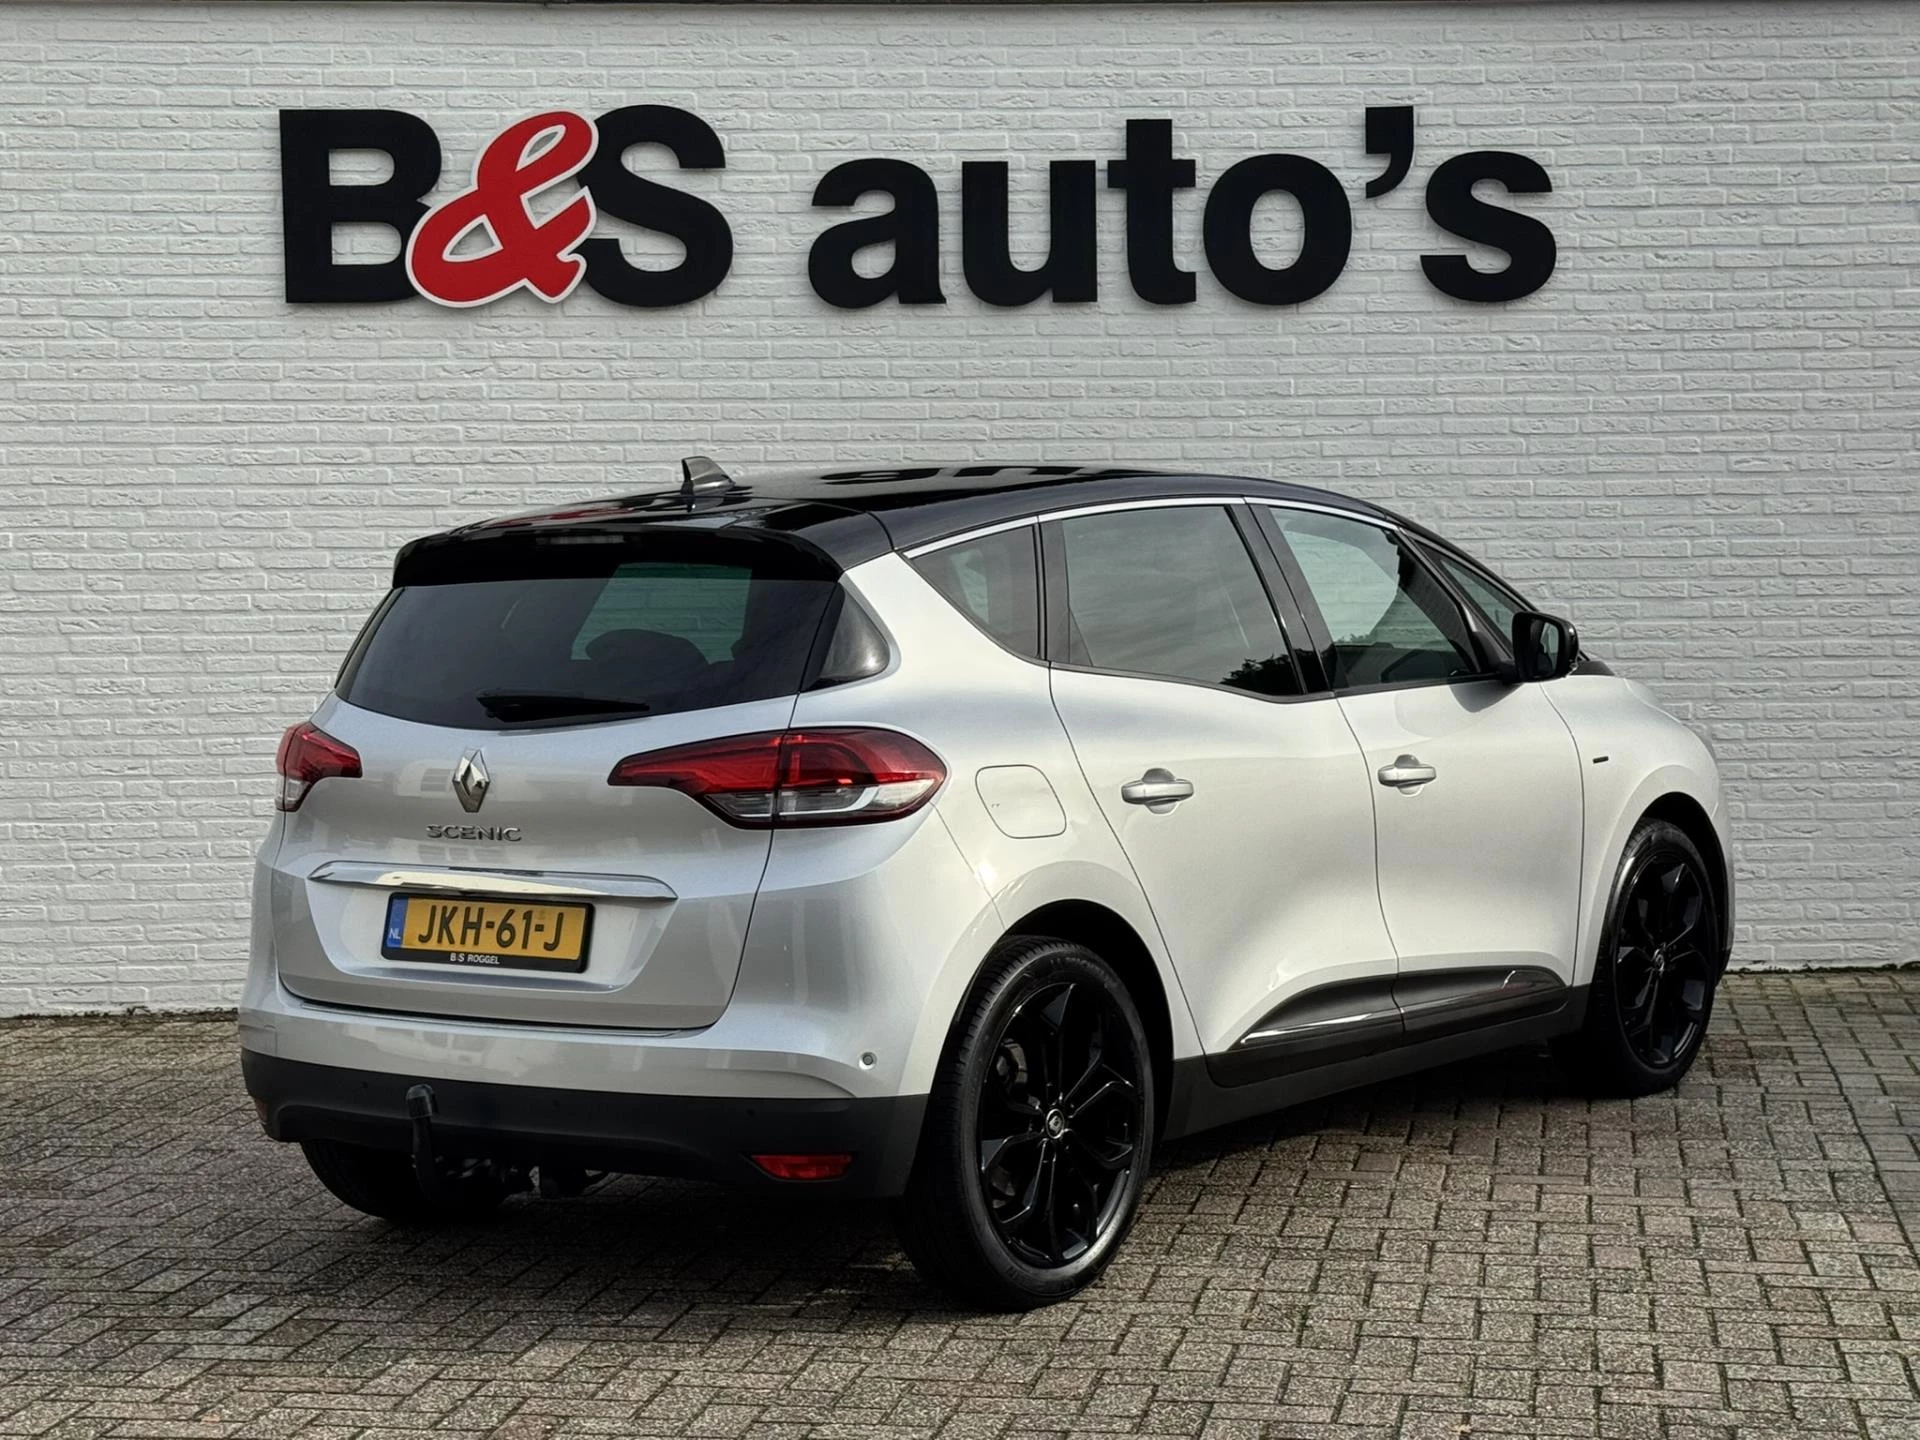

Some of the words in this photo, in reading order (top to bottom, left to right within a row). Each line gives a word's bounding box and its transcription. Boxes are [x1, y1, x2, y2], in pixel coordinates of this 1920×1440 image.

[280, 104, 734, 308] B&S
[808, 105, 1555, 309] auto's
[426, 824, 522, 842] SCENIC
[389, 928, 401, 940] NL
[418, 905, 564, 951] JKH-61-J
[467, 954, 500, 965] ROGGEL
